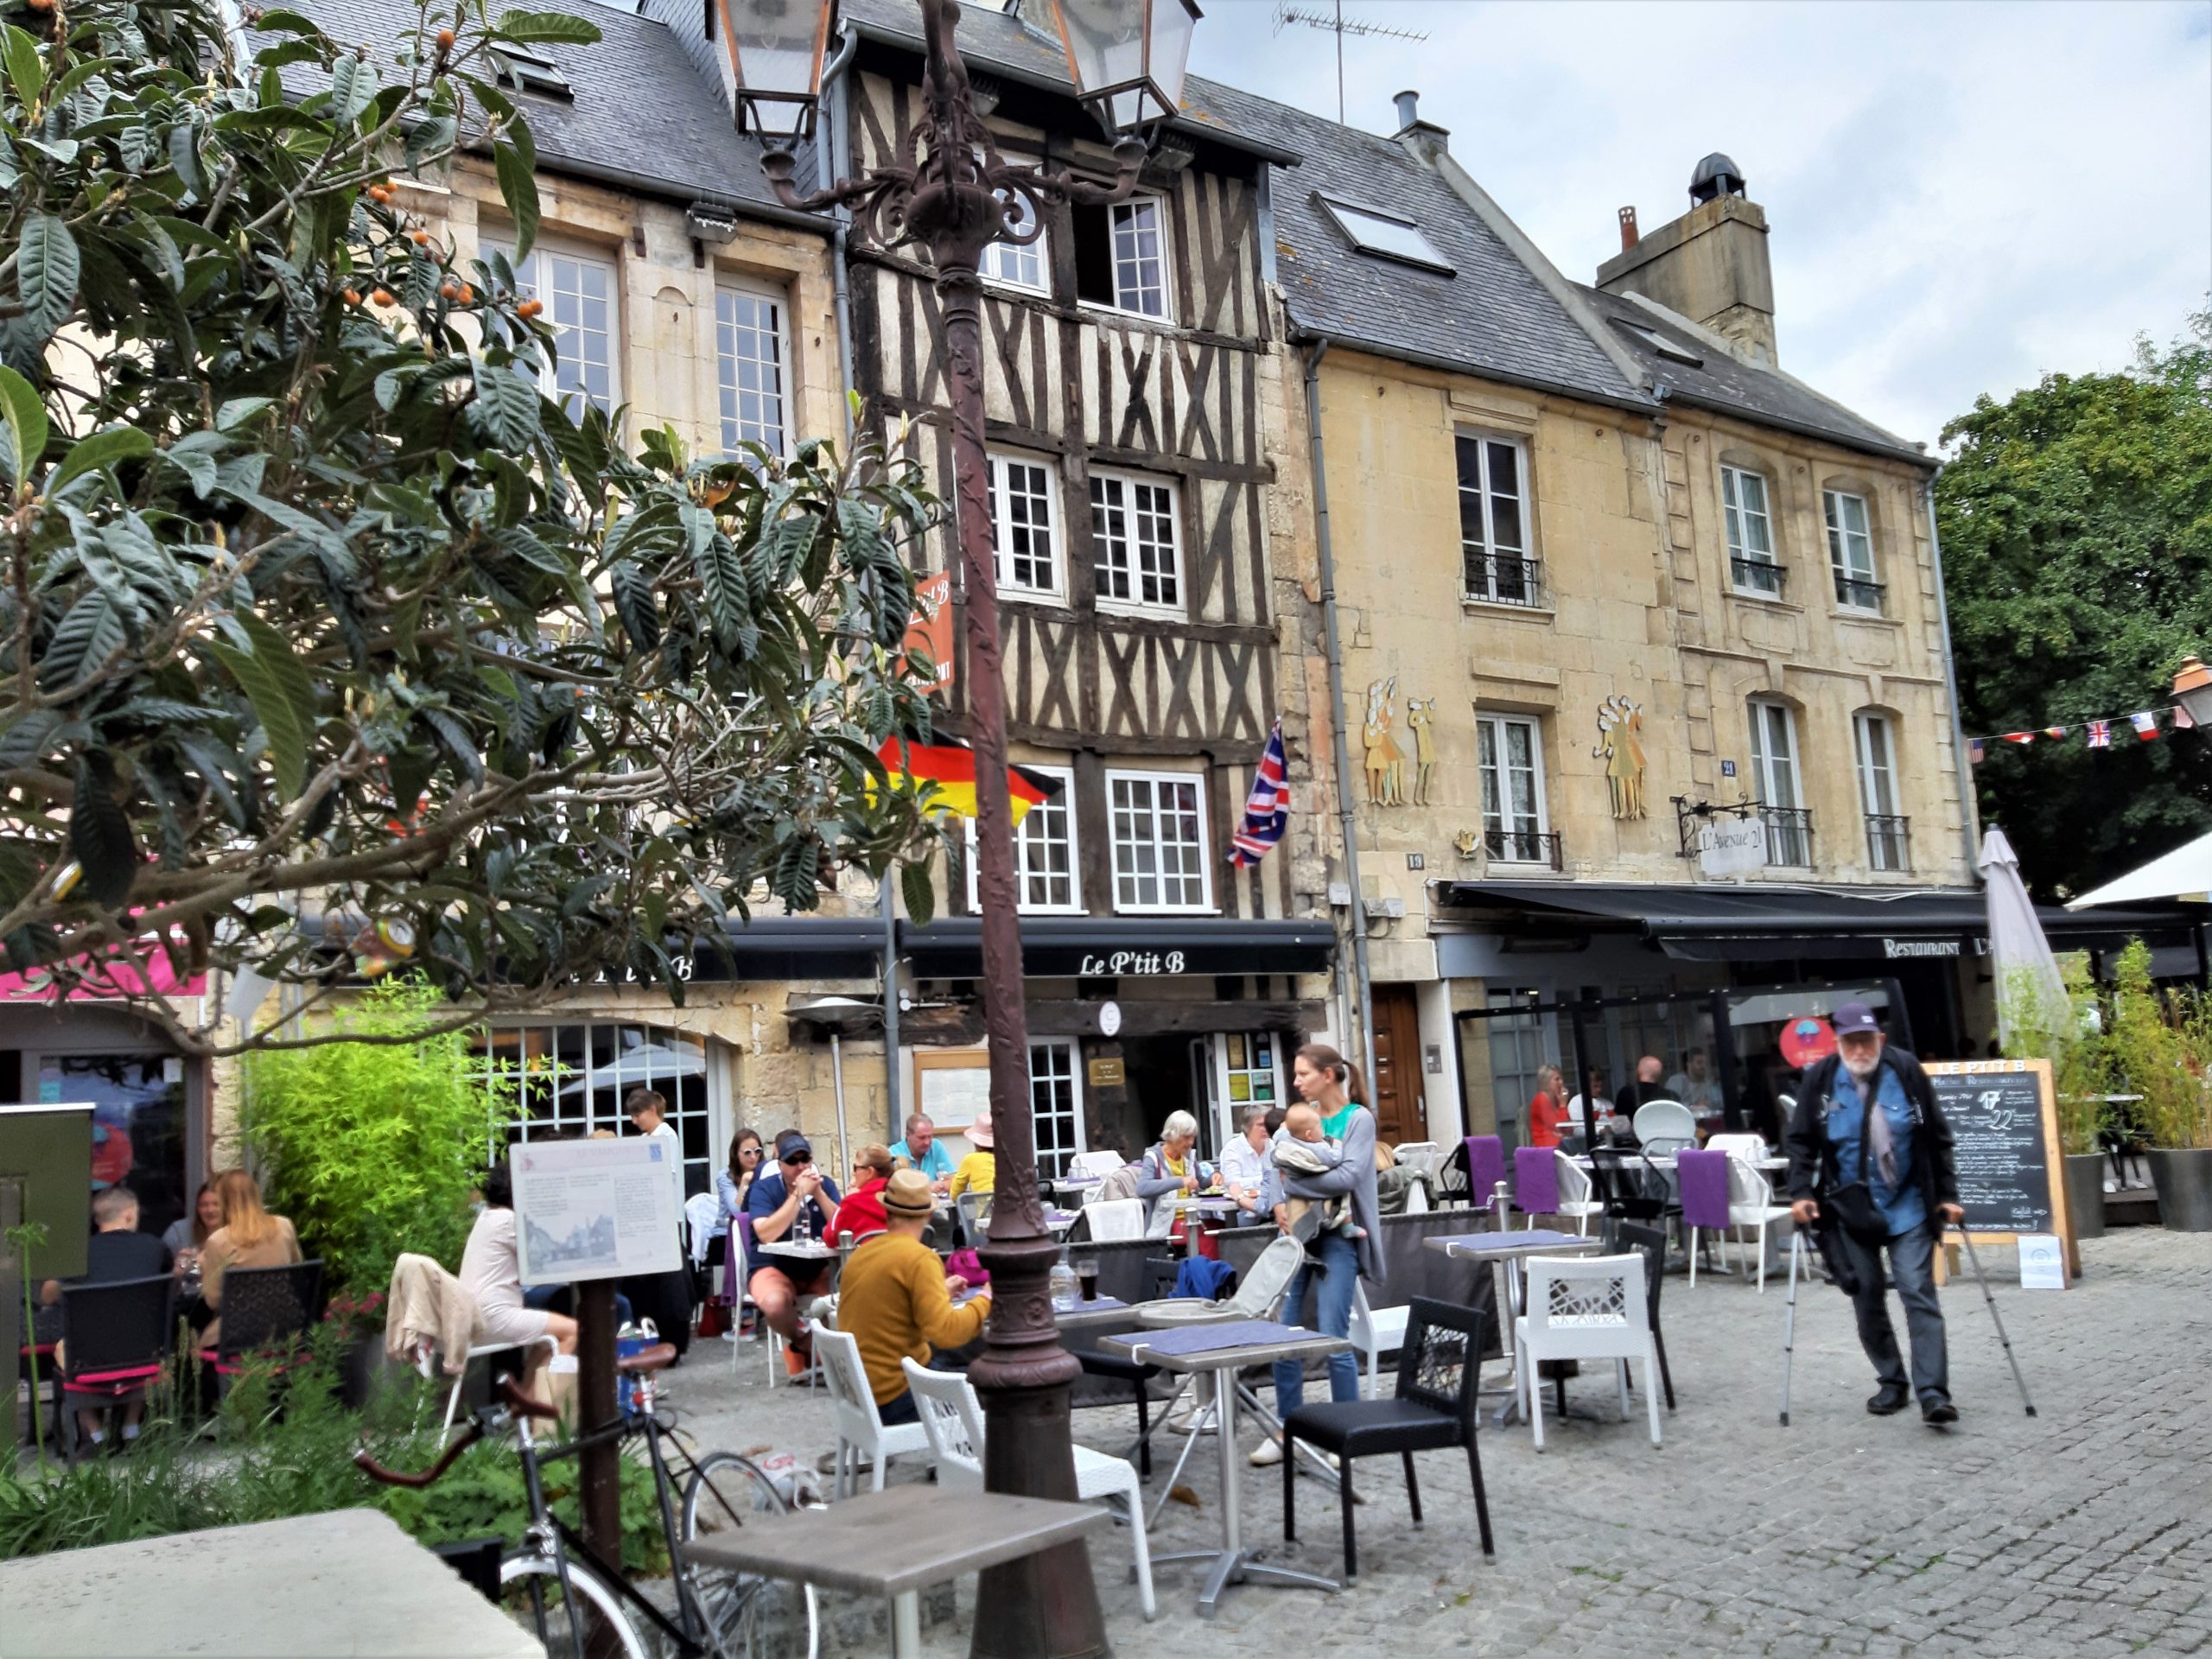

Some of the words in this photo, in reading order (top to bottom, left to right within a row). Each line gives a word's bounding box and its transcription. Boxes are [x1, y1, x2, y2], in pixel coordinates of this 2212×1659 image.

[1079, 954, 1105, 975] Le
[1109, 951, 1160, 975] P'tit
[1165, 950, 1185, 974] B
